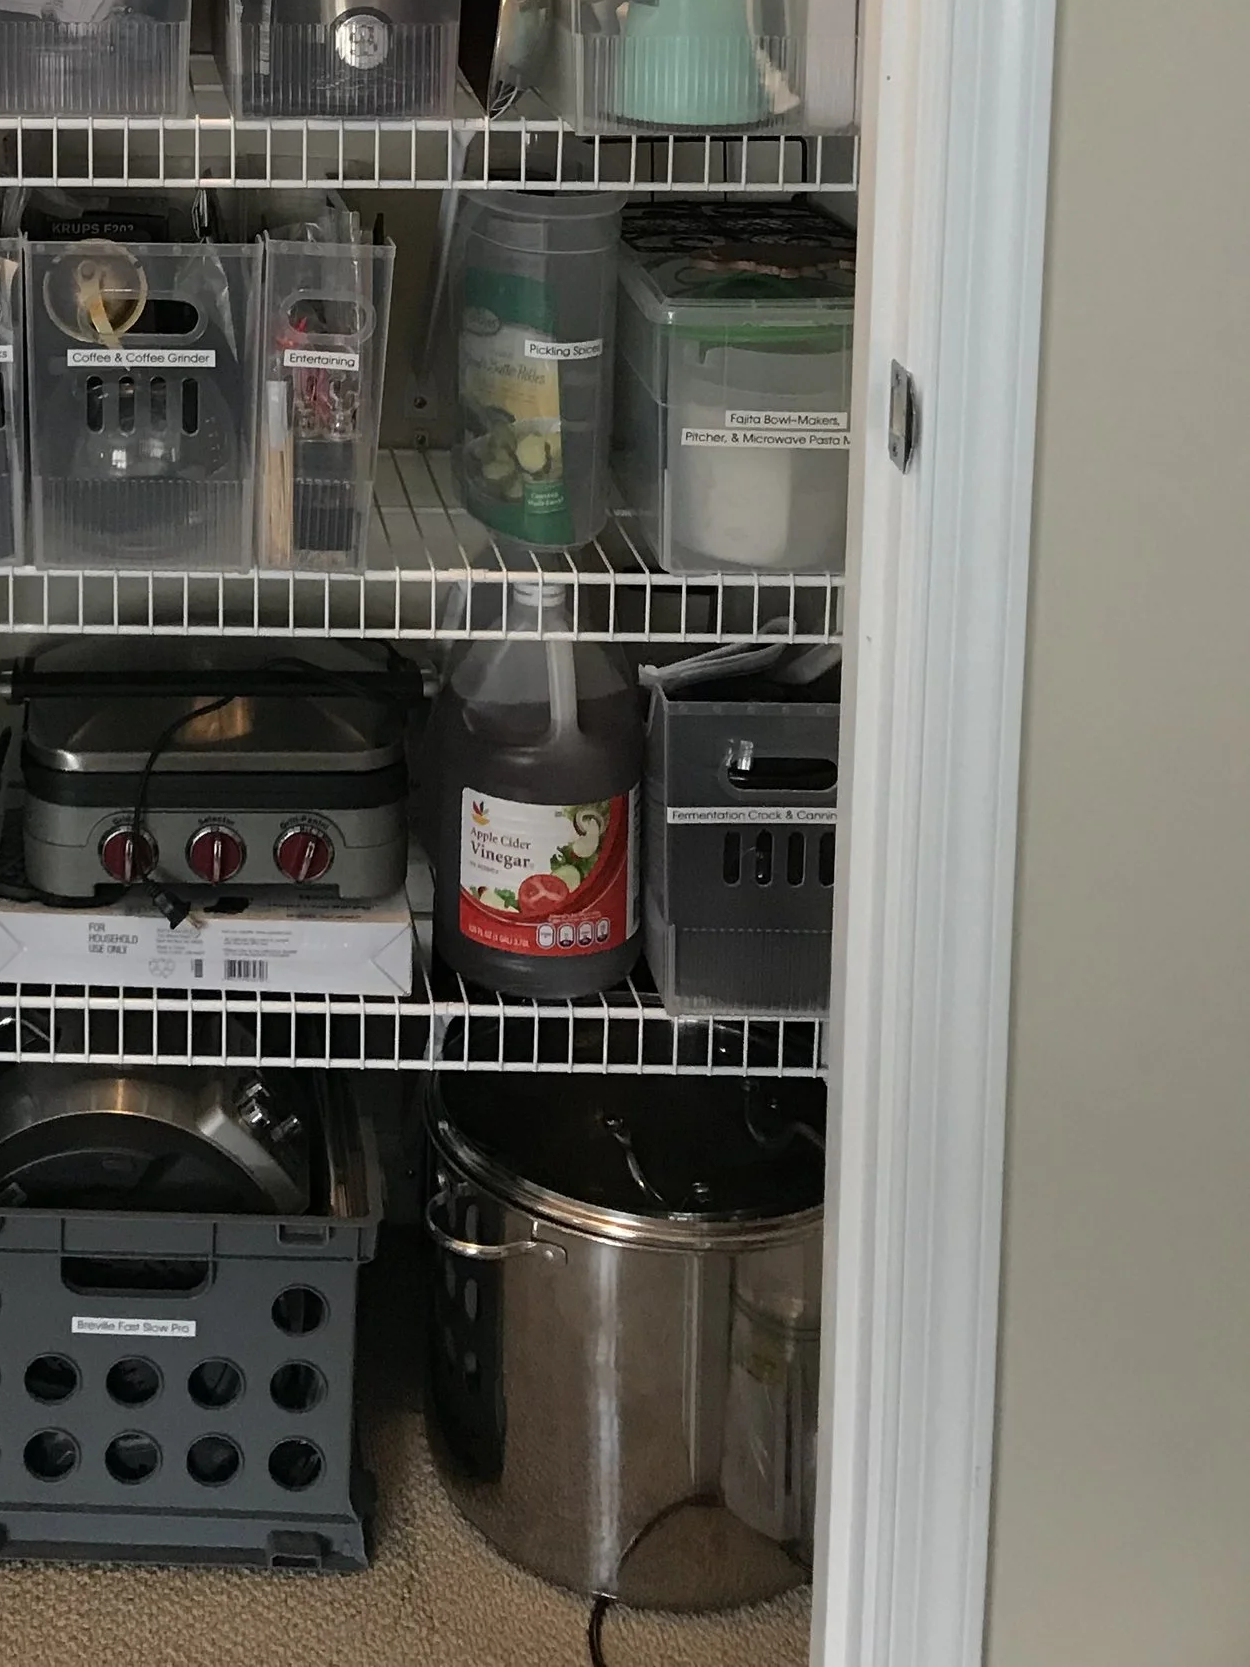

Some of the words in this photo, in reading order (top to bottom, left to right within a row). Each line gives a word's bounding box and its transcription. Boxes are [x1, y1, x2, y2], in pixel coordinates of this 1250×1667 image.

[52, 223, 100, 234] KRUPS
[529, 343, 571, 357] Pickling
[72, 352, 111, 363] Coffee
[114, 353, 123, 363] &
[125, 352, 165, 363] Coffee
[167, 353, 209, 363] Grinder
[289, 353, 356, 368] Entertaining
[730, 413, 761, 425] Fajita
[764, 414, 840, 426] Bowl-Makers,
[685, 432, 727, 444] Pitcher,
[731, 433, 739, 443] &
[743, 434, 806, 445] Microwave
[809, 435, 840, 445] Pasta
[672, 810, 746, 820] Fermentation
[748, 810, 781, 820] Crock
[785, 810, 793, 820] &
[470, 826, 498, 844] Apple
[500, 835, 531, 850] Cider
[470, 839, 531, 870] Vinegar
[88, 922, 105, 933] FOR
[88, 933, 139, 944] HOUSEHOLD
[88, 944, 105, 955] USE
[107, 944, 128, 955] ONLY
[77, 1320, 115, 1331] Breville
[118, 1321, 140, 1331] Fast
[142, 1322, 168, 1333] Slow
[171, 1323, 190, 1333] Pro
